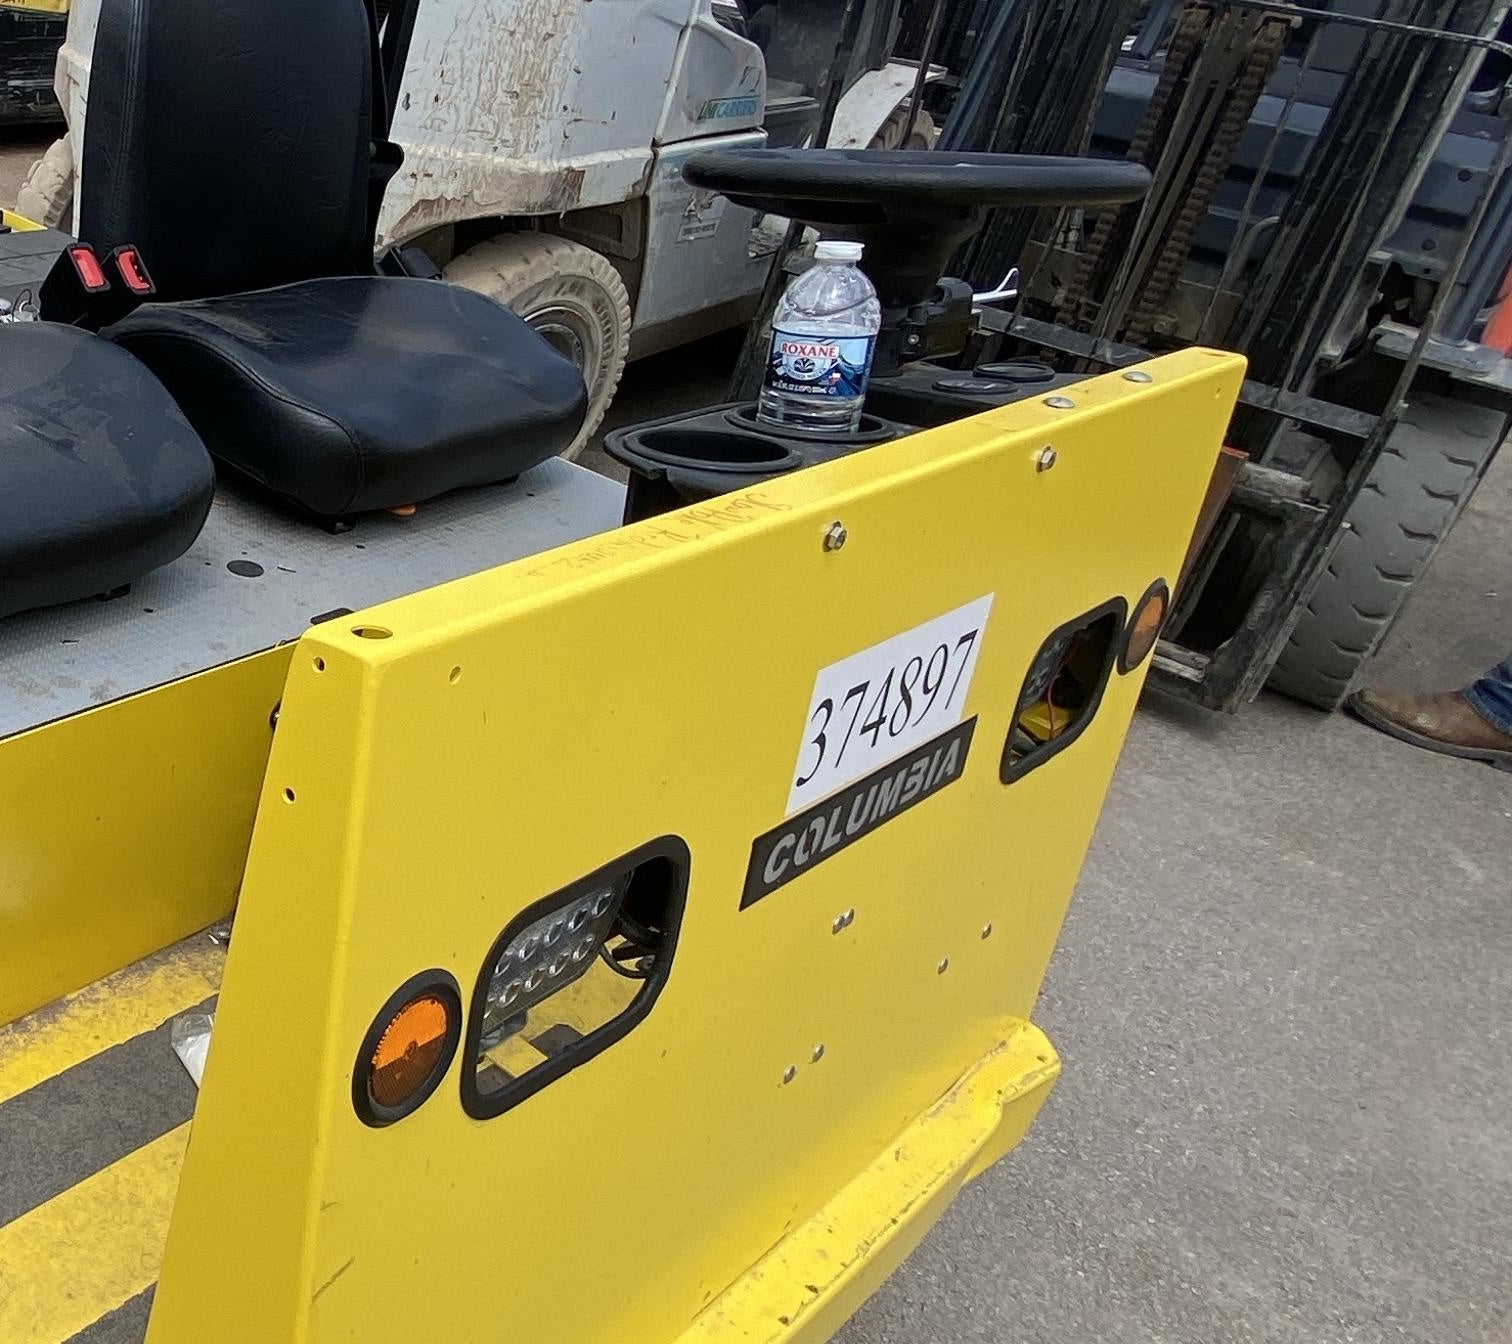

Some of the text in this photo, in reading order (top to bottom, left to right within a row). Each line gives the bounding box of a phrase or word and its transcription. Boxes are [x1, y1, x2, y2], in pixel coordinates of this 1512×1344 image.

[782, 342, 837, 358] ROXANE
[795, 628, 979, 788] 374897
[762, 737, 963, 885] COLUMBIA
